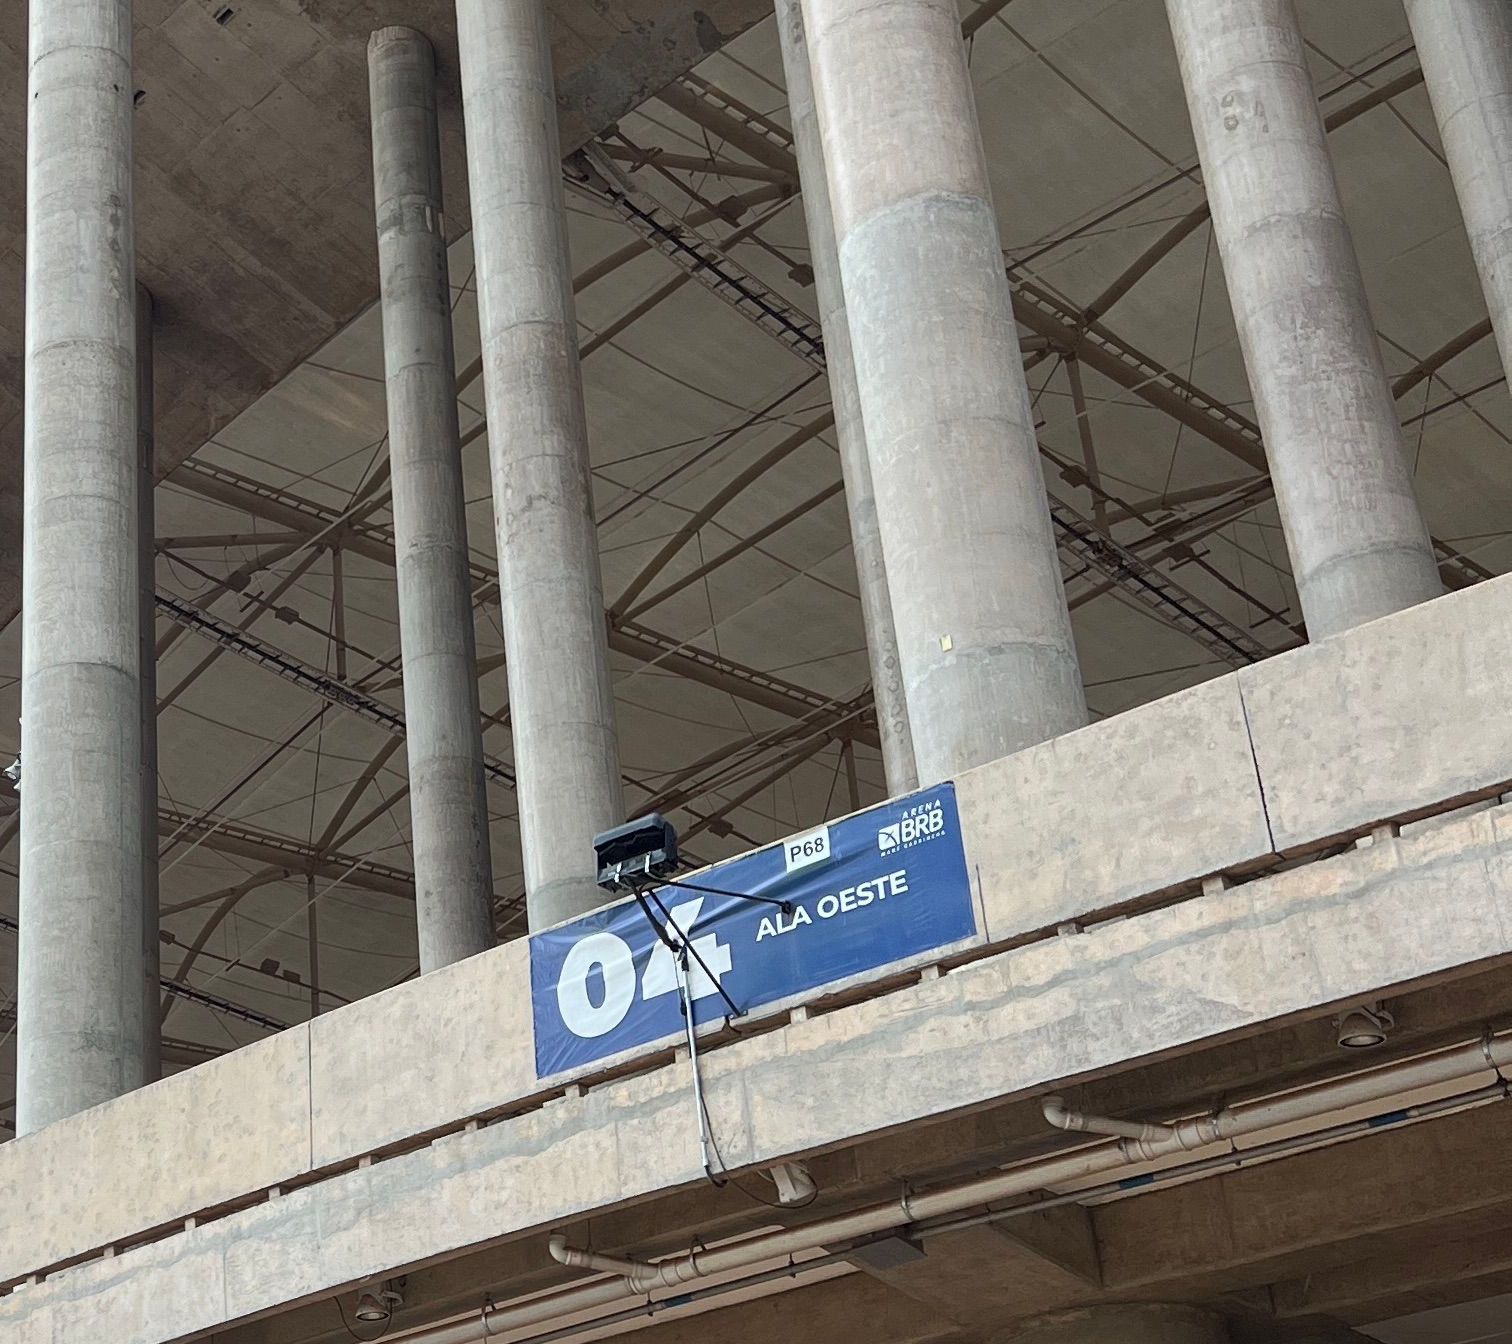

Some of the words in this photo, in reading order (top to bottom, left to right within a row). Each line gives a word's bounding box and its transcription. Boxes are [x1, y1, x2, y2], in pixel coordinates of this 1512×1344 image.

[901, 809, 944, 843] BRB
[902, 799, 941, 820] ARENA
[790, 837, 825, 863] P68
[756, 905, 812, 942] ALA
[816, 869, 909, 919] OESTE
[556, 896, 734, 1038] 04
